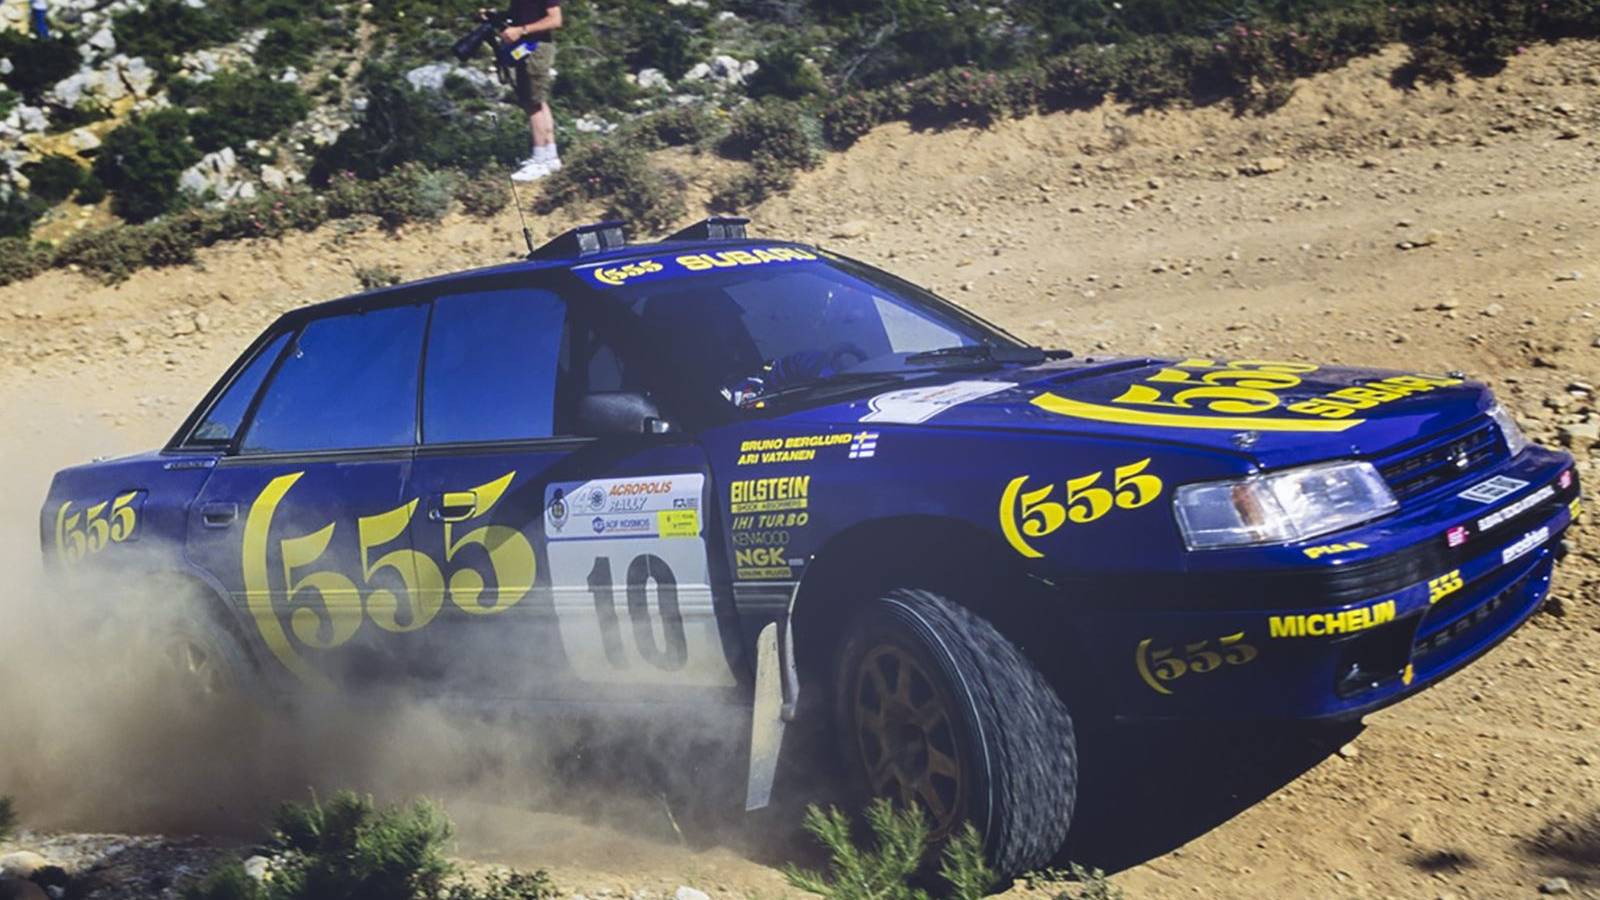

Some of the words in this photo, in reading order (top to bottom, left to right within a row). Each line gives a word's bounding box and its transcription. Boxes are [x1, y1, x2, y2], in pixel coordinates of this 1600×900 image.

[675, 247, 818, 271] SUBARU
[1286, 373, 1464, 418] SUBARU
[740, 438, 783, 452] BRUNO
[785, 433, 852, 449] BERGLUND
[737, 453, 759, 466] ARI
[761, 449, 816, 464] VATANEN
[609, 481, 673, 497] ACROPOLIS
[730, 475, 811, 503] BILSTEIN
[609, 497, 648, 512] RALLY
[732, 516, 755, 530] IHI
[758, 512, 809, 529] TURBO
[732, 530, 790, 546] KENWOOD
[735, 546, 787, 567] NGK
[586, 552, 689, 672] 10
[1268, 599, 1397, 639] MICHELIN
